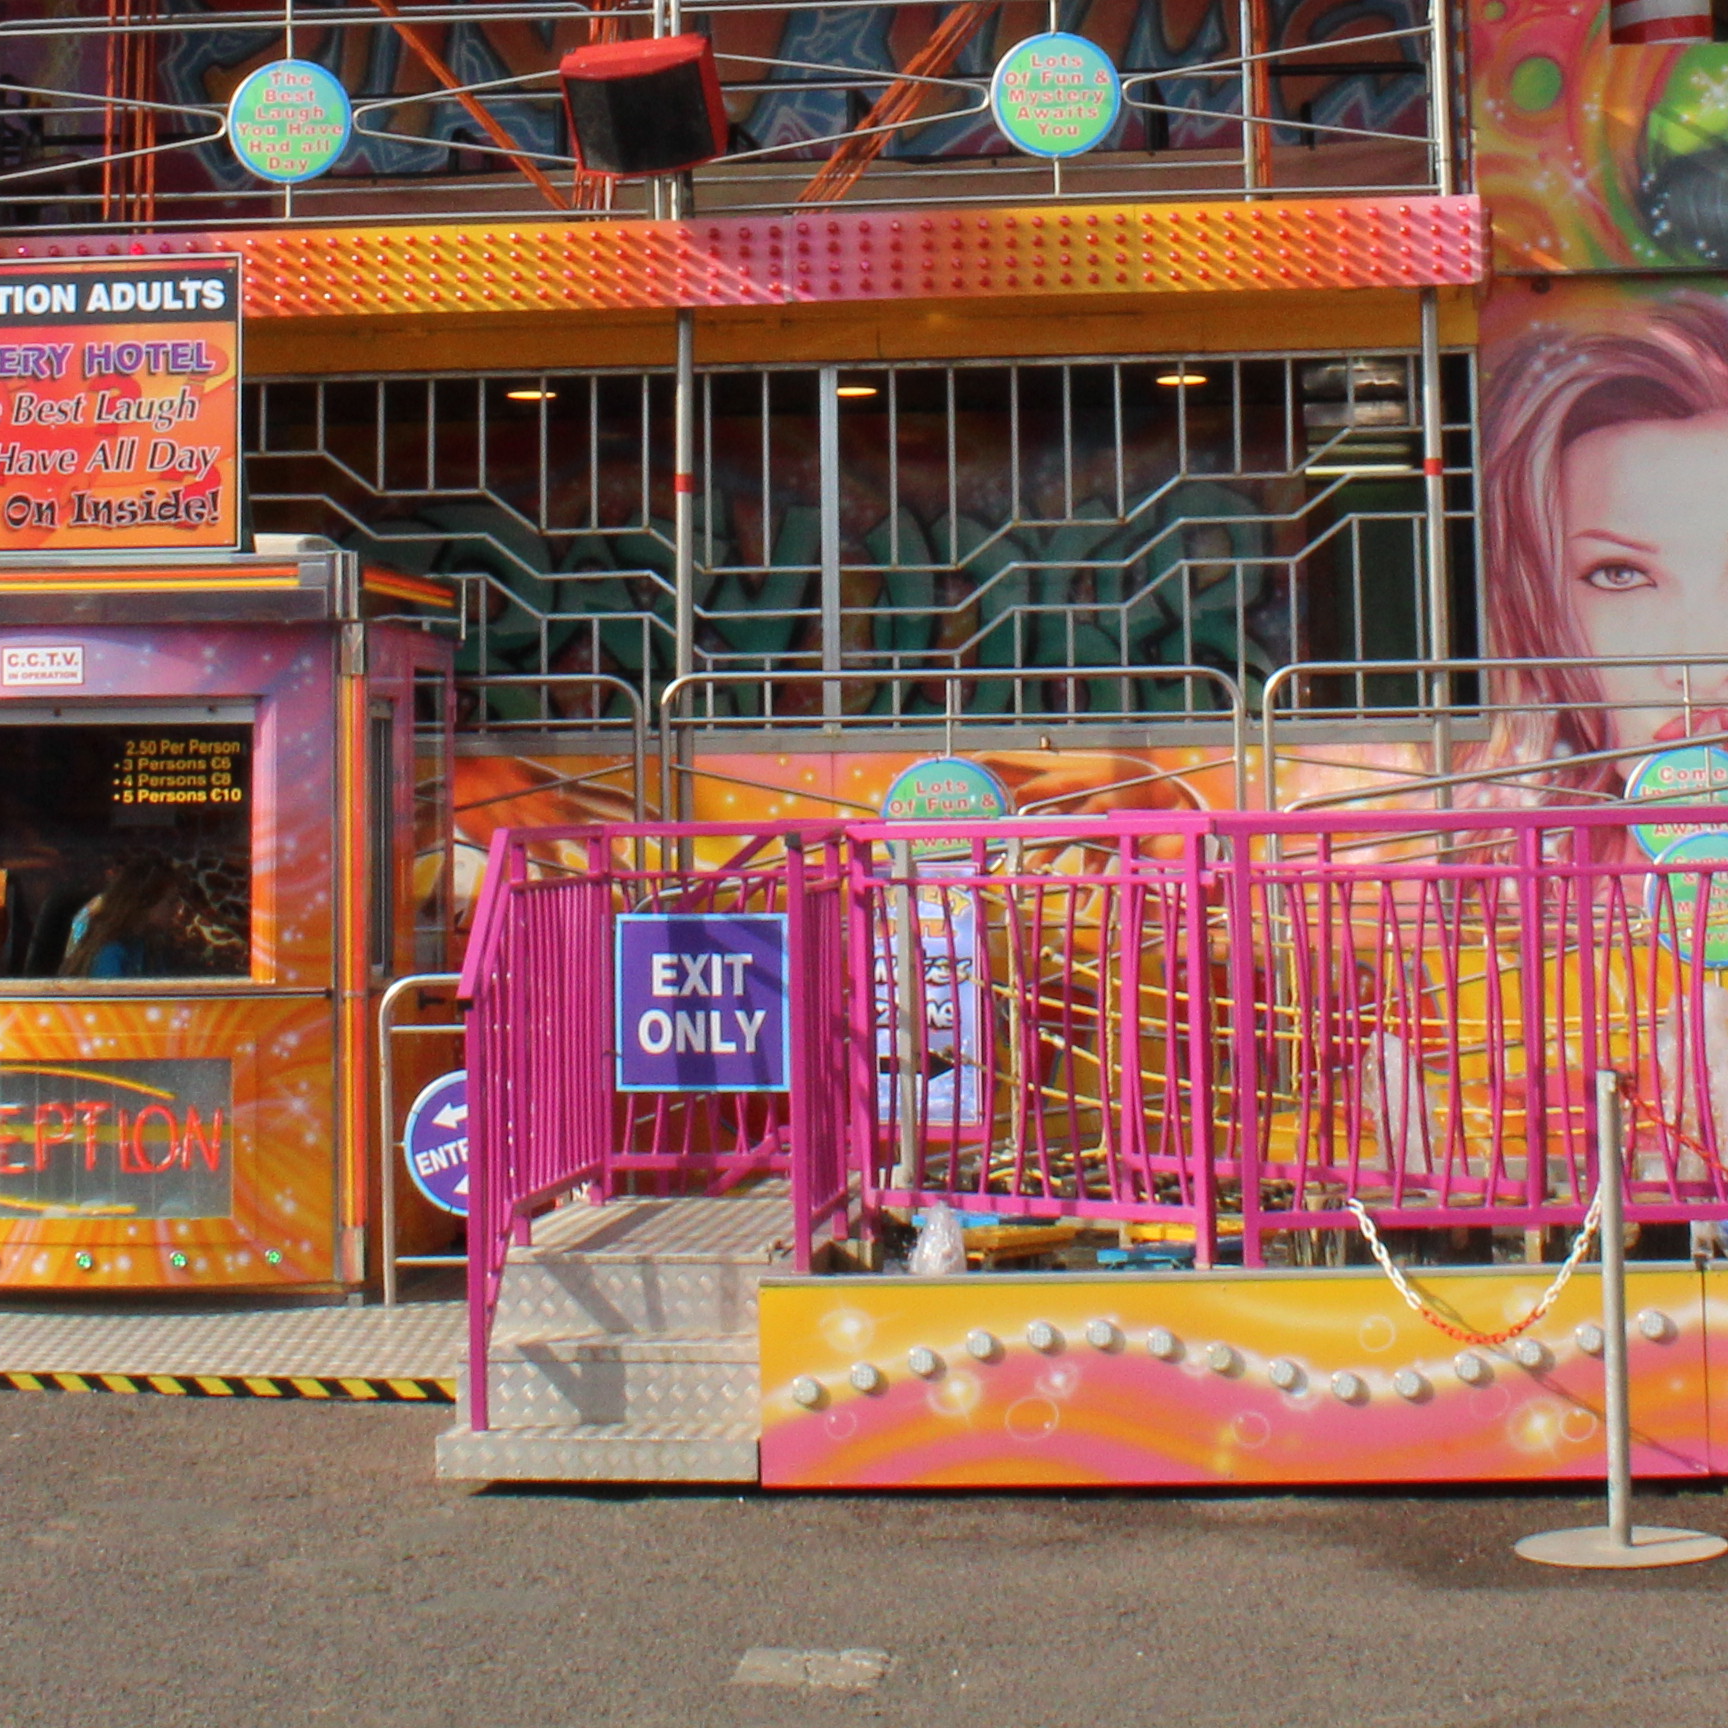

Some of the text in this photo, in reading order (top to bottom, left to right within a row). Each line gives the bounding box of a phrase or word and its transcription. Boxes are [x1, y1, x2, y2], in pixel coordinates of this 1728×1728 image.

[1030, 54, 1083, 68] Lots
[271, 72, 312, 86] The
[1004, 69, 1110, 86] Of Fun &
[264, 89, 316, 103] Best
[1008, 89, 1105, 104] Mystery
[255, 107, 324, 122] Laugh
[1016, 106, 1099, 120] Awaits
[237, 123, 344, 136] You Have
[1036, 122, 1080, 136] You
[248, 139, 330, 153] Had all
[267, 157, 308, 174] Day
[85, 279, 226, 313] ADULTS
[83, 341, 217, 375] HOTEL
[12, 391, 84, 424] Best
[94, 386, 198, 431] Laugh
[86, 437, 137, 472] All
[147, 440, 221, 480] Day
[5, 493, 60, 525] On
[70, 487, 222, 527] Inside!
[7, 652, 79, 668] C.C.T.V.
[160, 738, 186, 754] Per
[189, 738, 241, 755] Person
[137, 757, 207, 771] Persons
[122, 774, 134, 787] 4
[137, 774, 207, 787] Persons
[915, 780, 969, 796] Lots
[122, 787, 242, 803] 5 Persons €10
[889, 793, 996, 815] Of Fun &
[651, 953, 754, 997] EXIT
[637, 1008, 768, 1055] ONLY
